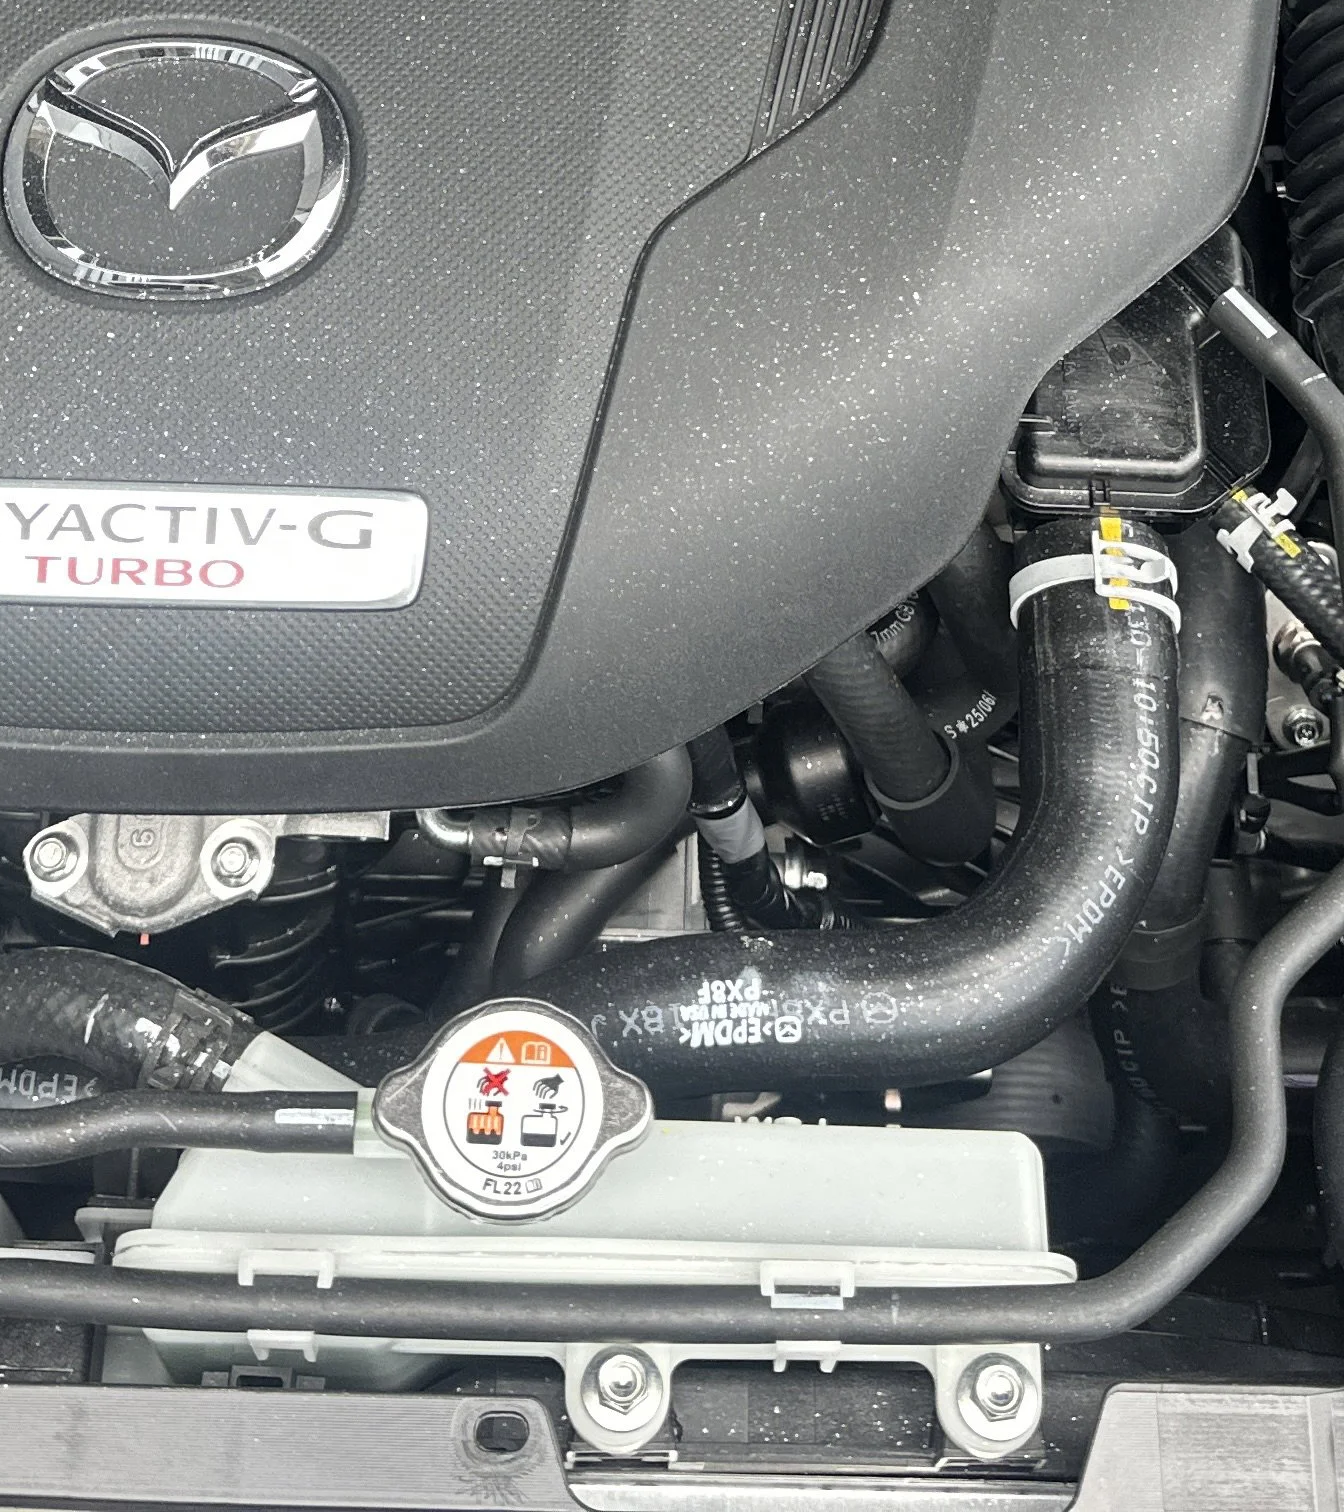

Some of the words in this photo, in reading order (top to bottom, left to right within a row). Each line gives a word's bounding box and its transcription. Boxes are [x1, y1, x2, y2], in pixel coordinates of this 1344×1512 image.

[25, 555, 245, 588] TURBO
[696, 978, 760, 1002] PX8F
[491, 1150, 528, 1161] 30kPa
